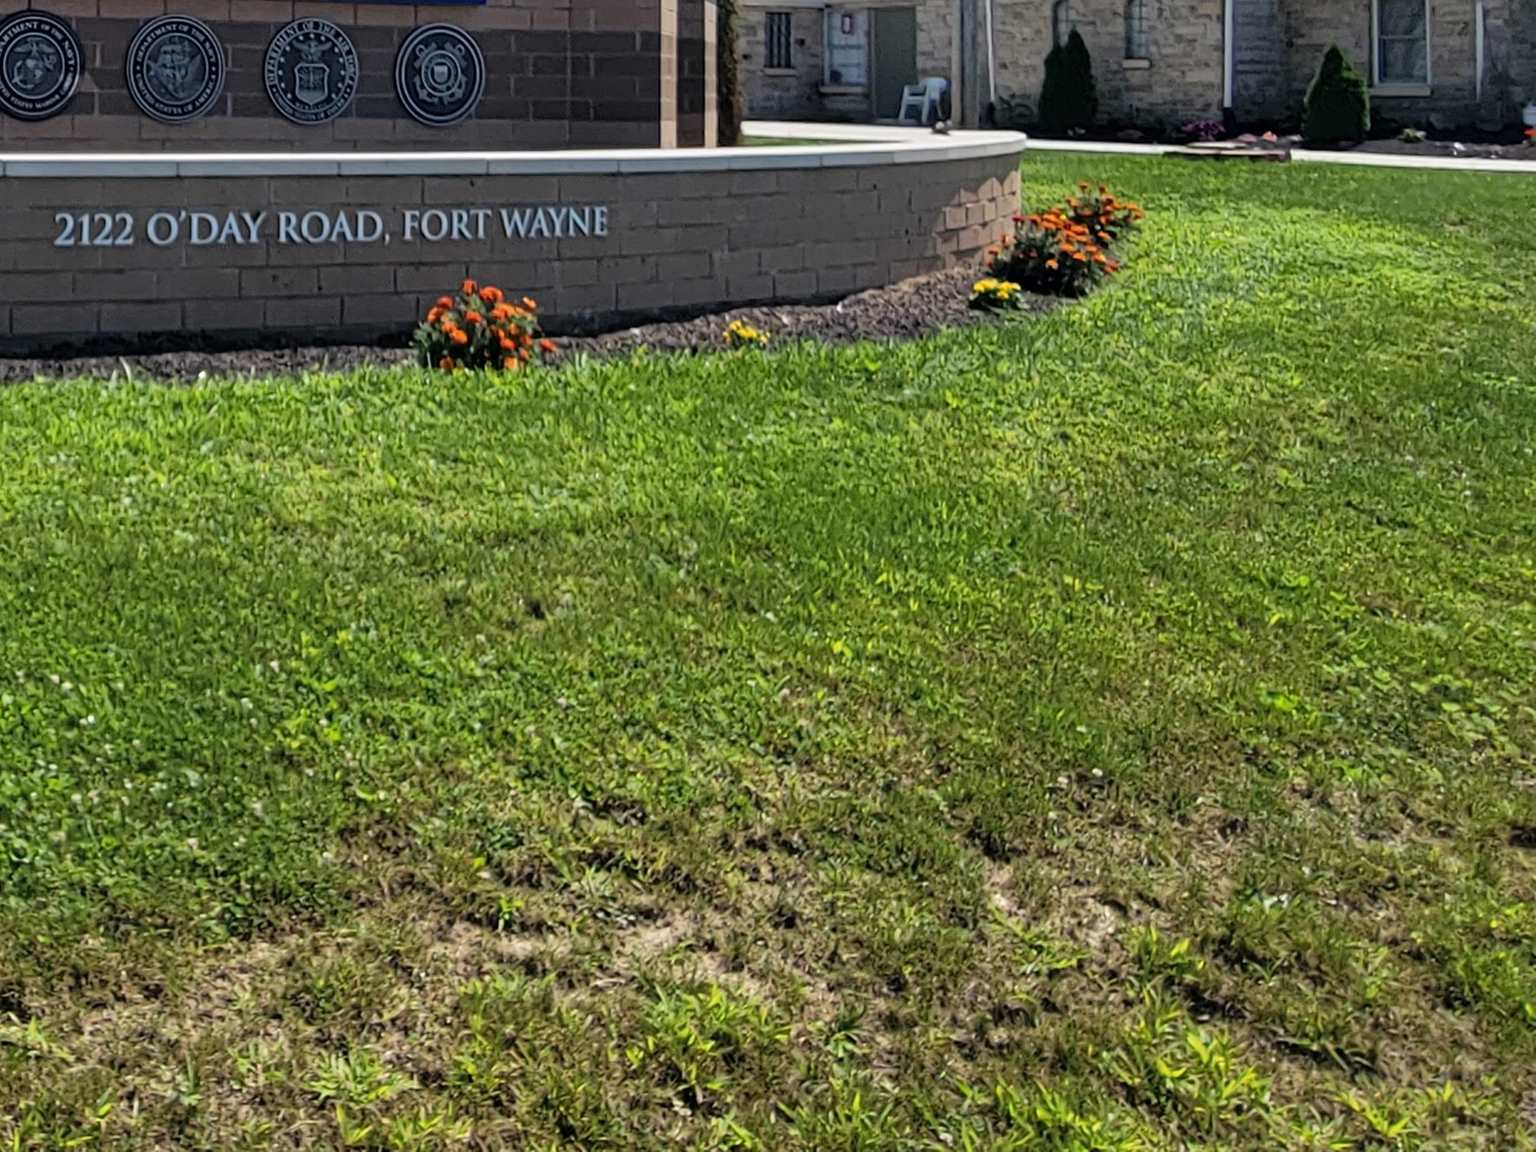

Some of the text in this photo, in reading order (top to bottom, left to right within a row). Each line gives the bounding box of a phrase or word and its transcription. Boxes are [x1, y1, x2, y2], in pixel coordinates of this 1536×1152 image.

[54, 206, 608, 245] 2122 O'DAY ROAD, FORT WAYNE
